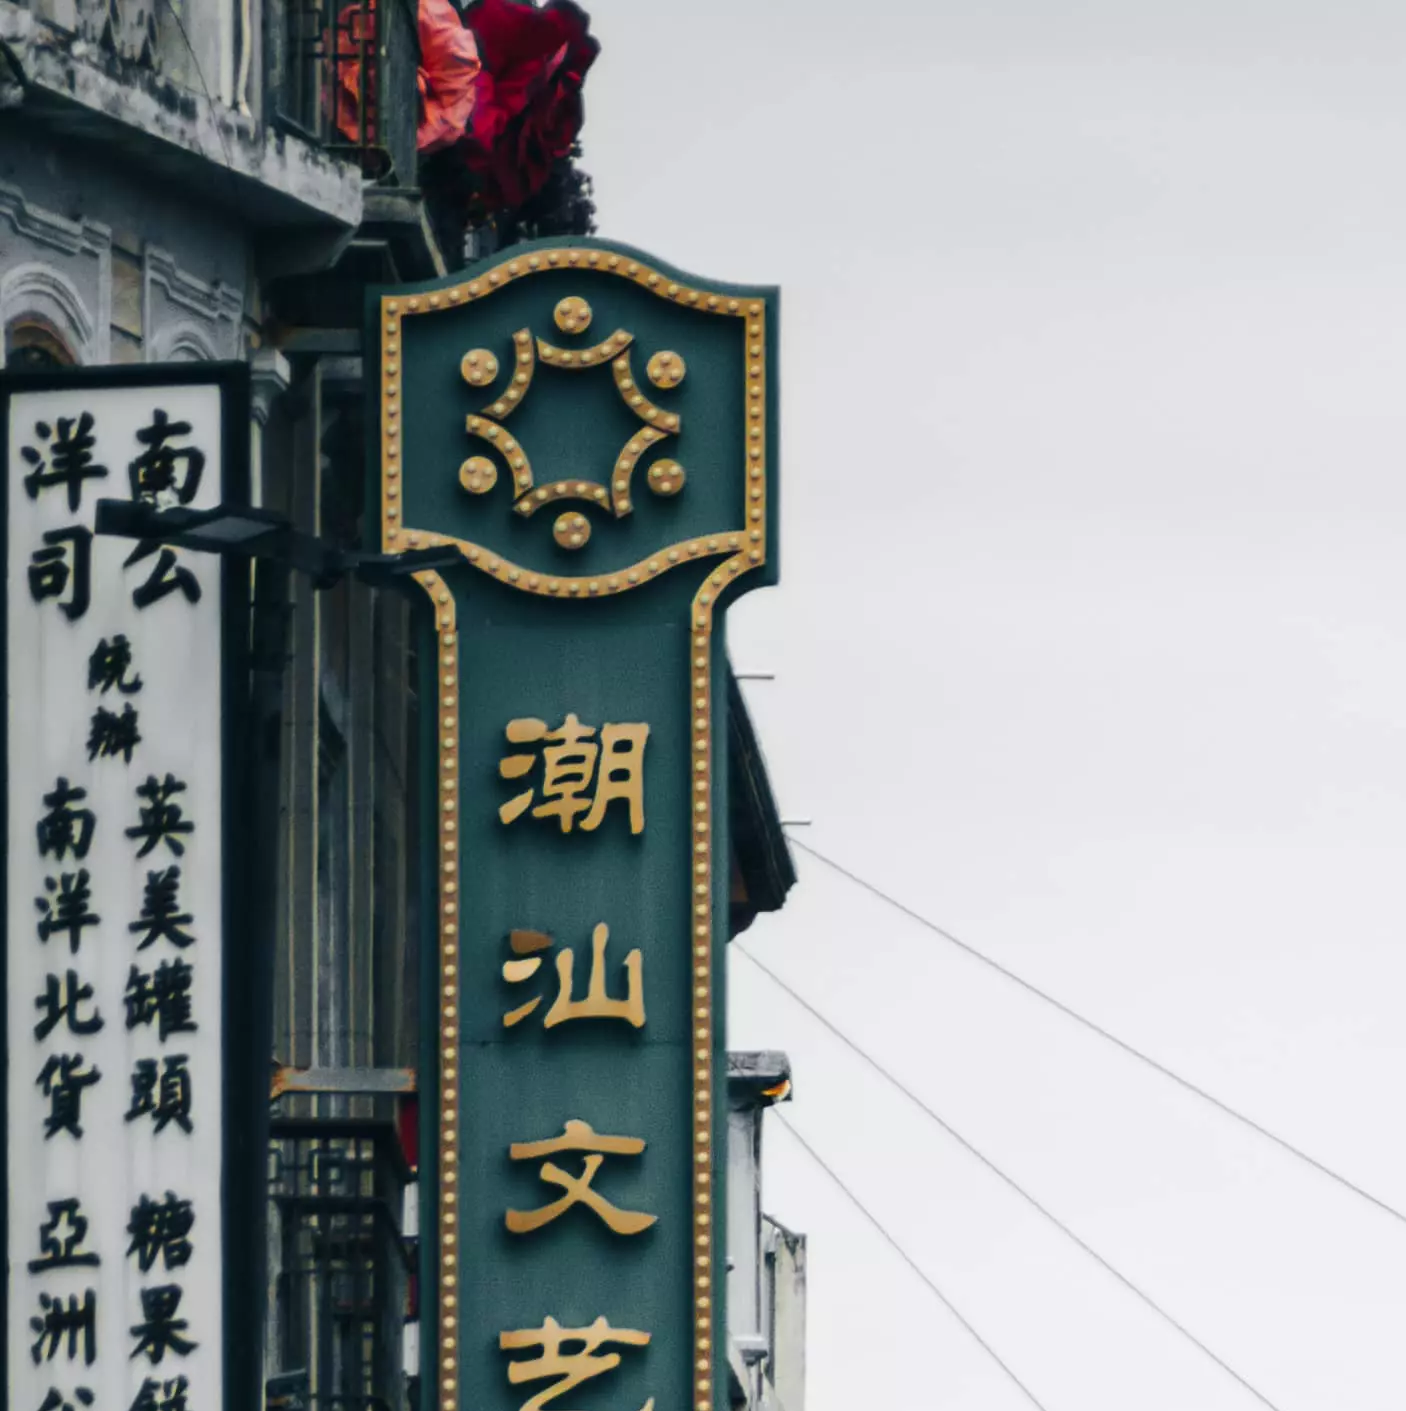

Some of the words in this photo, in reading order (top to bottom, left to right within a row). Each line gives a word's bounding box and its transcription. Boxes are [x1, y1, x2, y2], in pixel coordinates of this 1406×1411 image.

[32, 774, 106, 1142] 南洋北貨
[123, 772, 198, 1138] 英美罐頭
